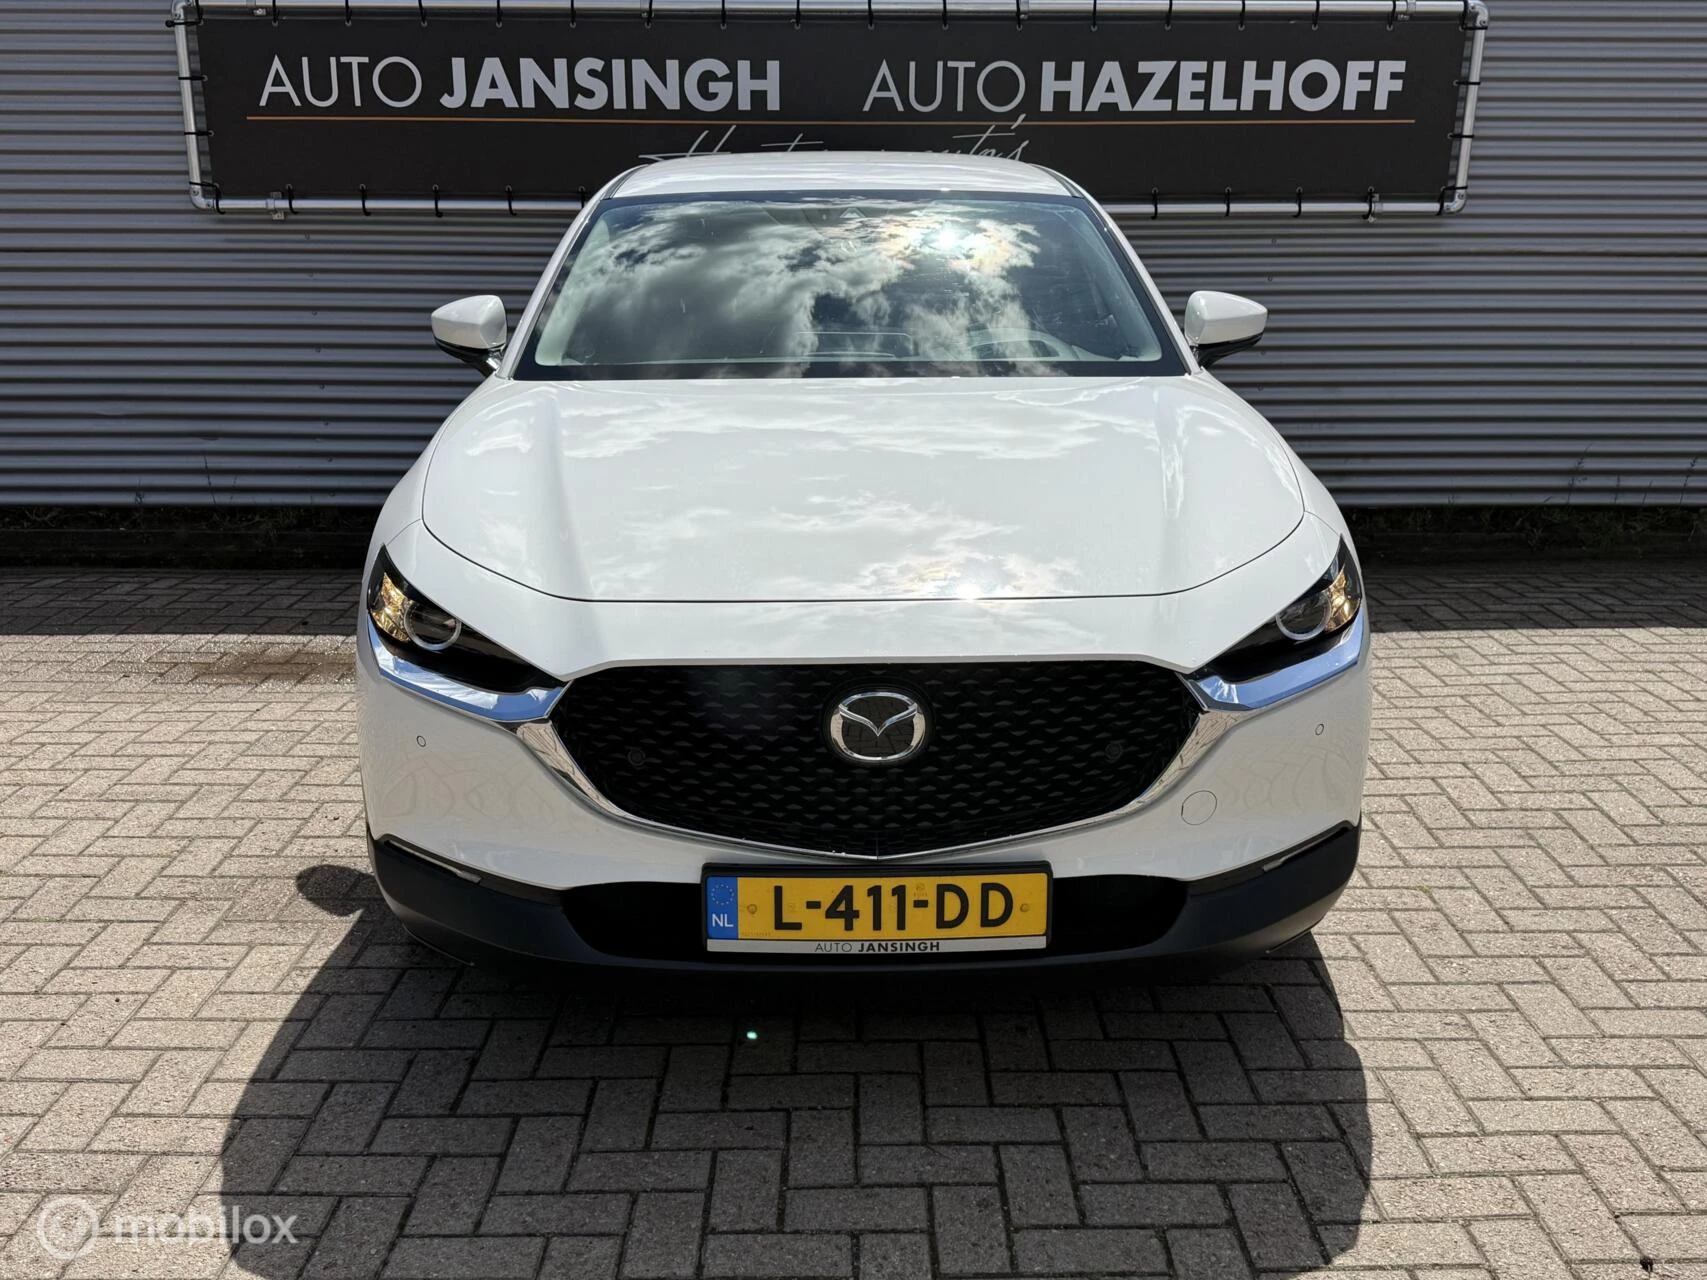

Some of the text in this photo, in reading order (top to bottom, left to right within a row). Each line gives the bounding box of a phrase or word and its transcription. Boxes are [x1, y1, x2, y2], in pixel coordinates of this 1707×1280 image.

[259, 54, 781, 112] AUTO JANSINGH
[862, 58, 1406, 113] AUTO HAZELHOFF
[711, 913, 734, 928] NL
[773, 882, 1014, 932] L-411-DD
[814, 941, 940, 953] AUTO JANSINGH
